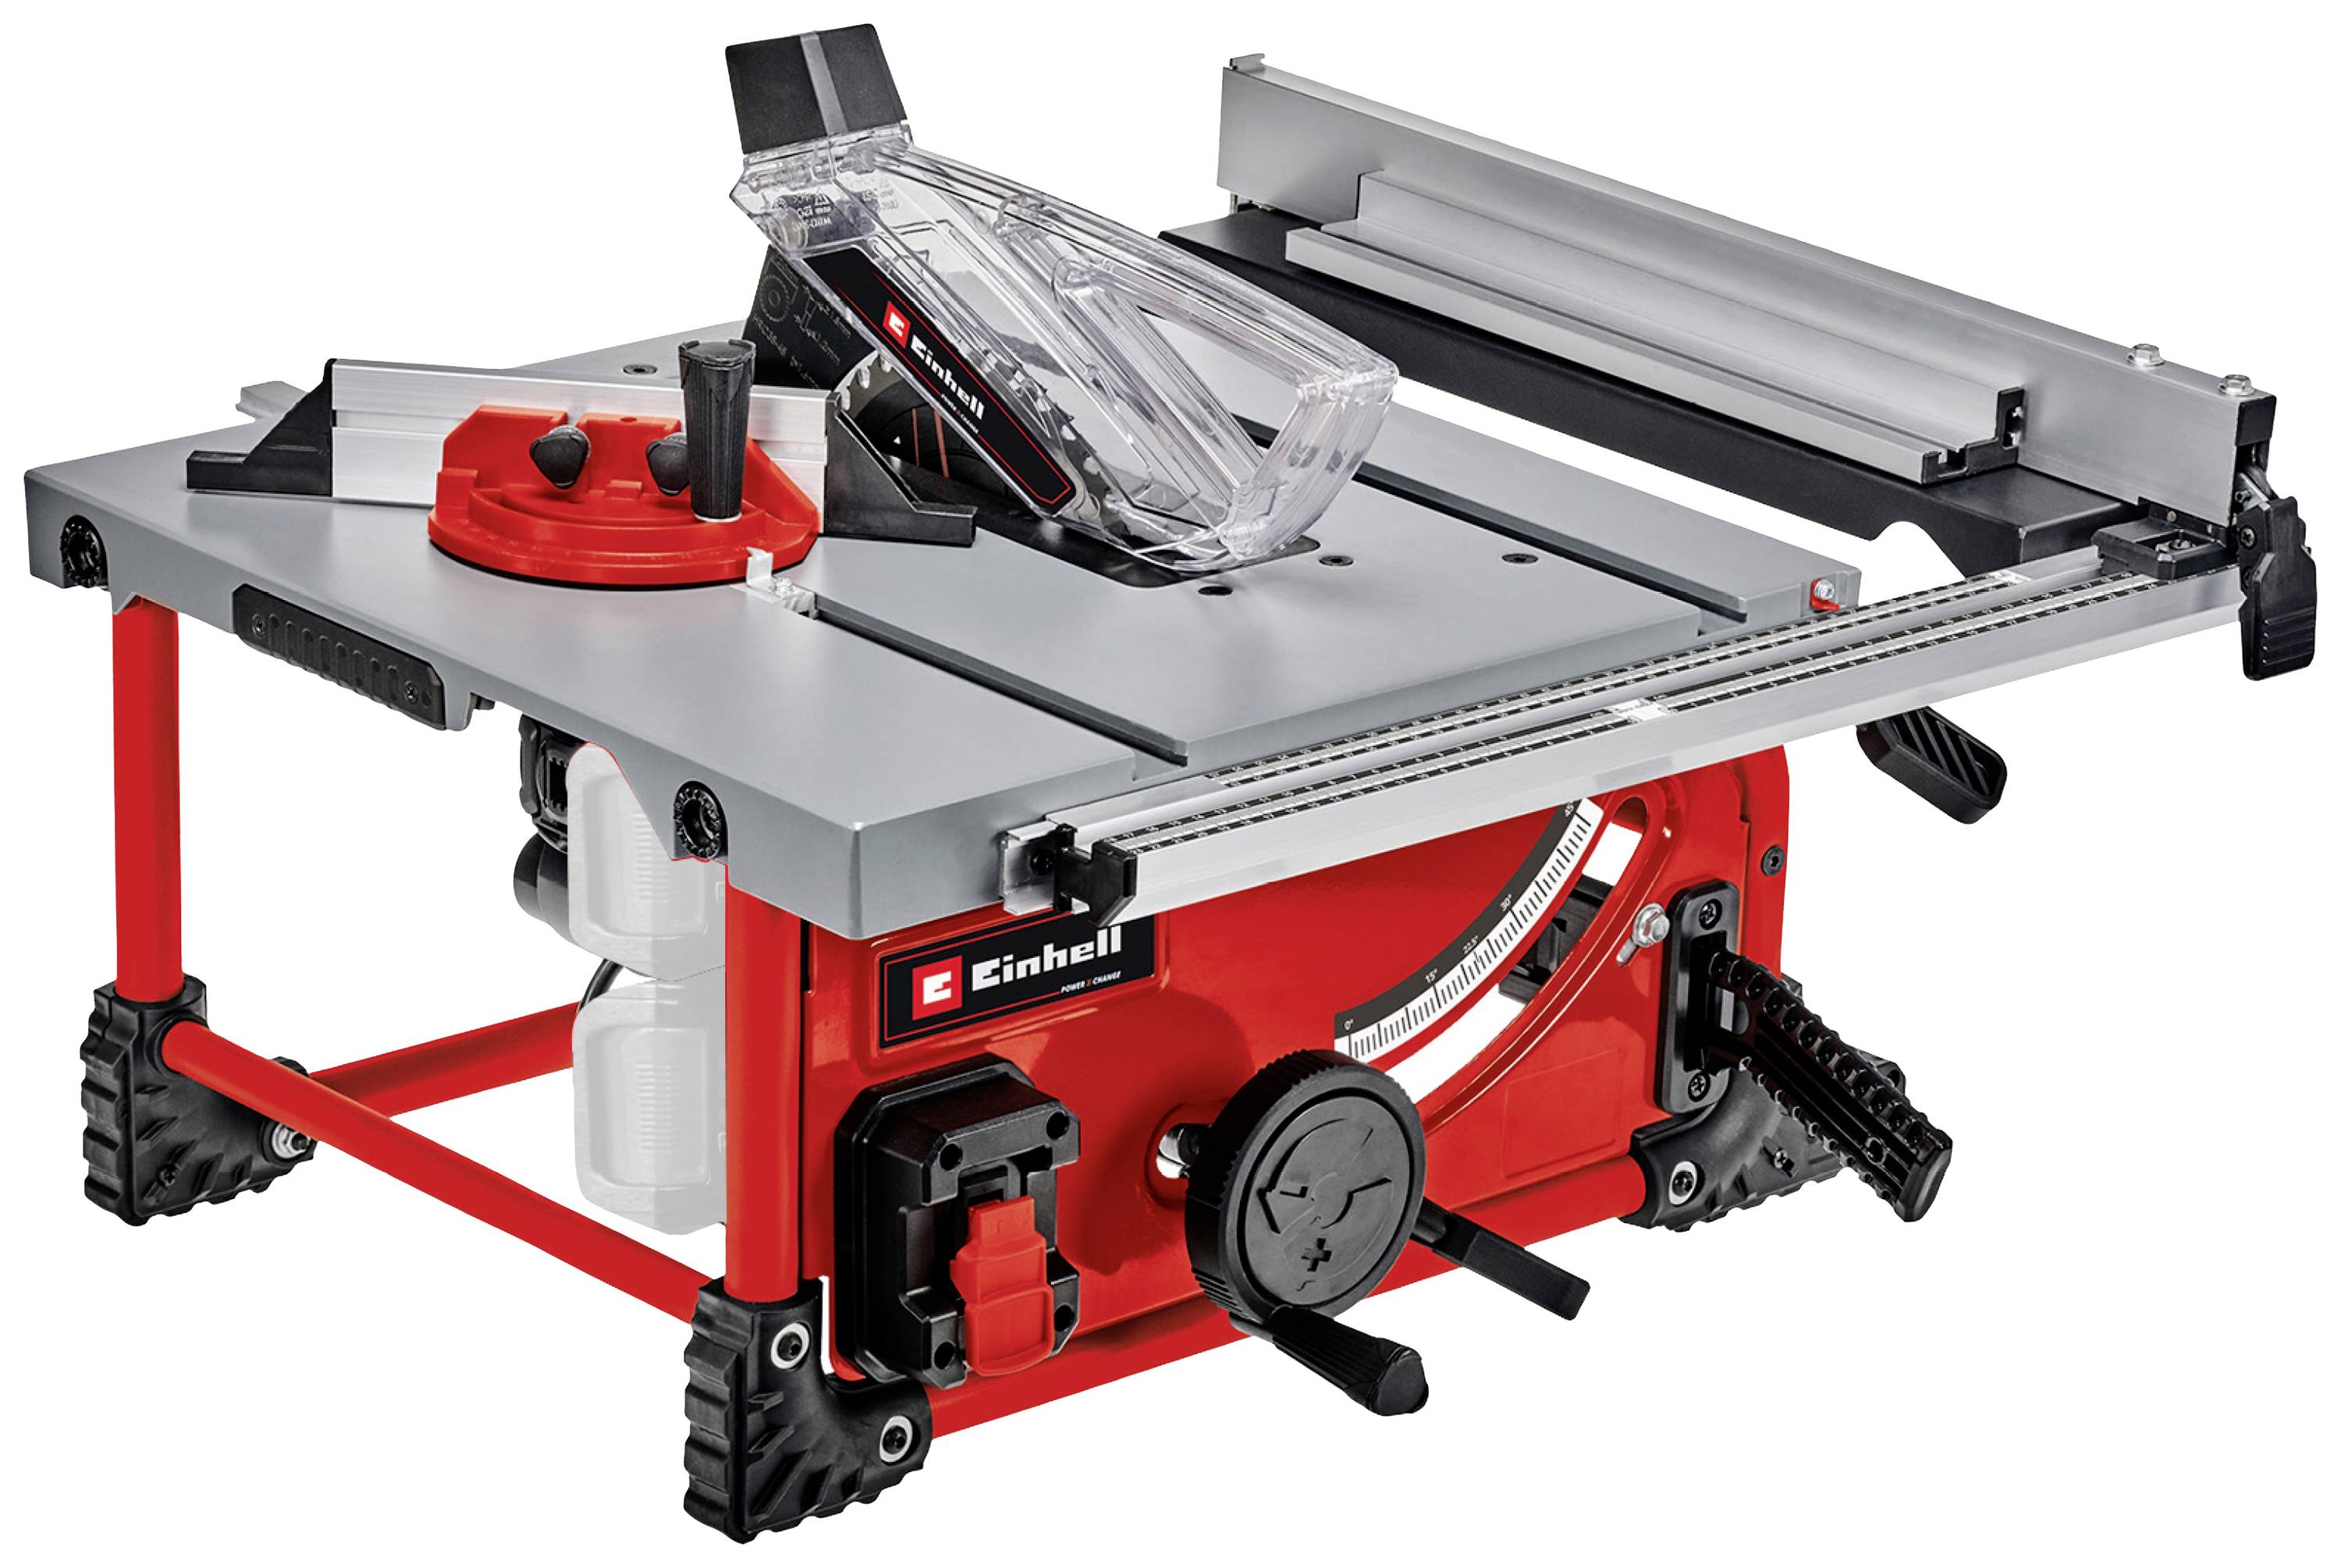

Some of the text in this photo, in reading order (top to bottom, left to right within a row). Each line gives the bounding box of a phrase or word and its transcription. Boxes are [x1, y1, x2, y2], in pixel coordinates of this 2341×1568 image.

[911, 334, 985, 420] Einhell
[972, 924, 1122, 992] Einhell
[1060, 979, 1086, 995] POWER
